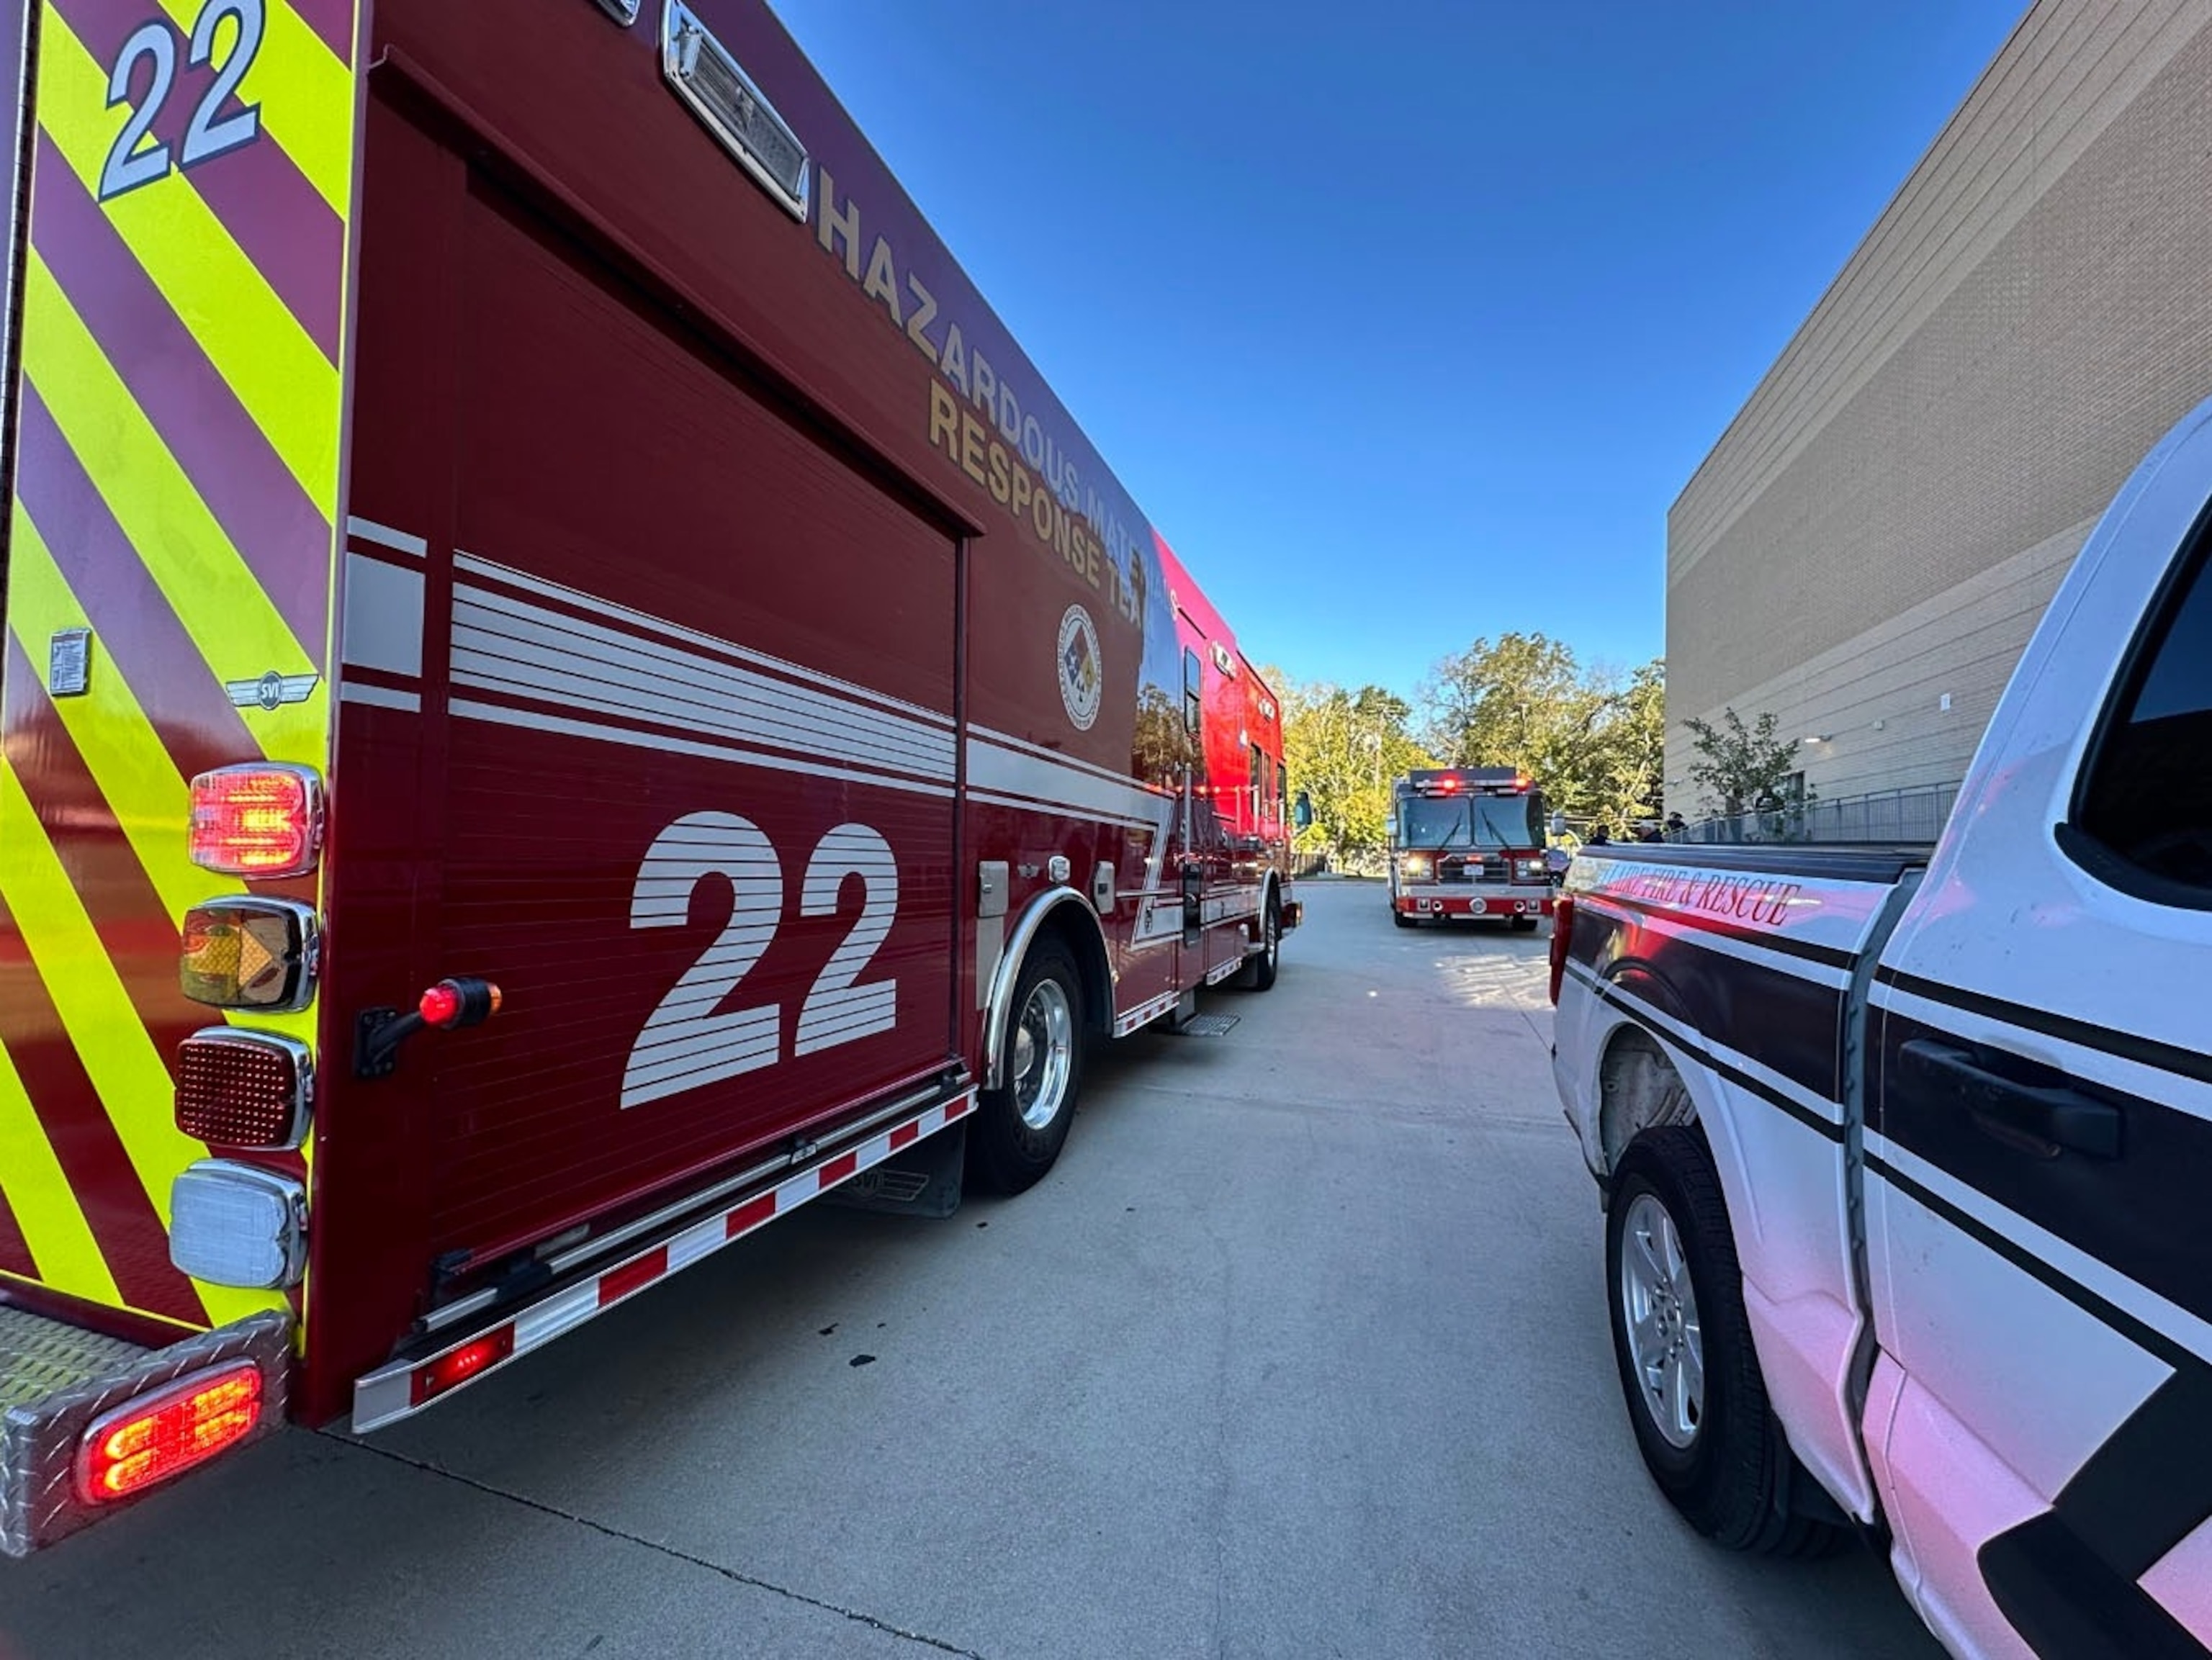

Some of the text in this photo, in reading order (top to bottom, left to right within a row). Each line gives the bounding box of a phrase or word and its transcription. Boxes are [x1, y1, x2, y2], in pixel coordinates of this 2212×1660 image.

[98, 0, 261, 203] 22
[817, 165, 1079, 514] HAZARDOUS
[928, 377, 1101, 590] RESPONSE
[261, 681, 280, 700] SVI
[620, 810, 899, 1110] 22
[1640, 867, 1688, 903] FIRE
[1678, 871, 1703, 907] &
[1696, 874, 1802, 926] RESCUE
